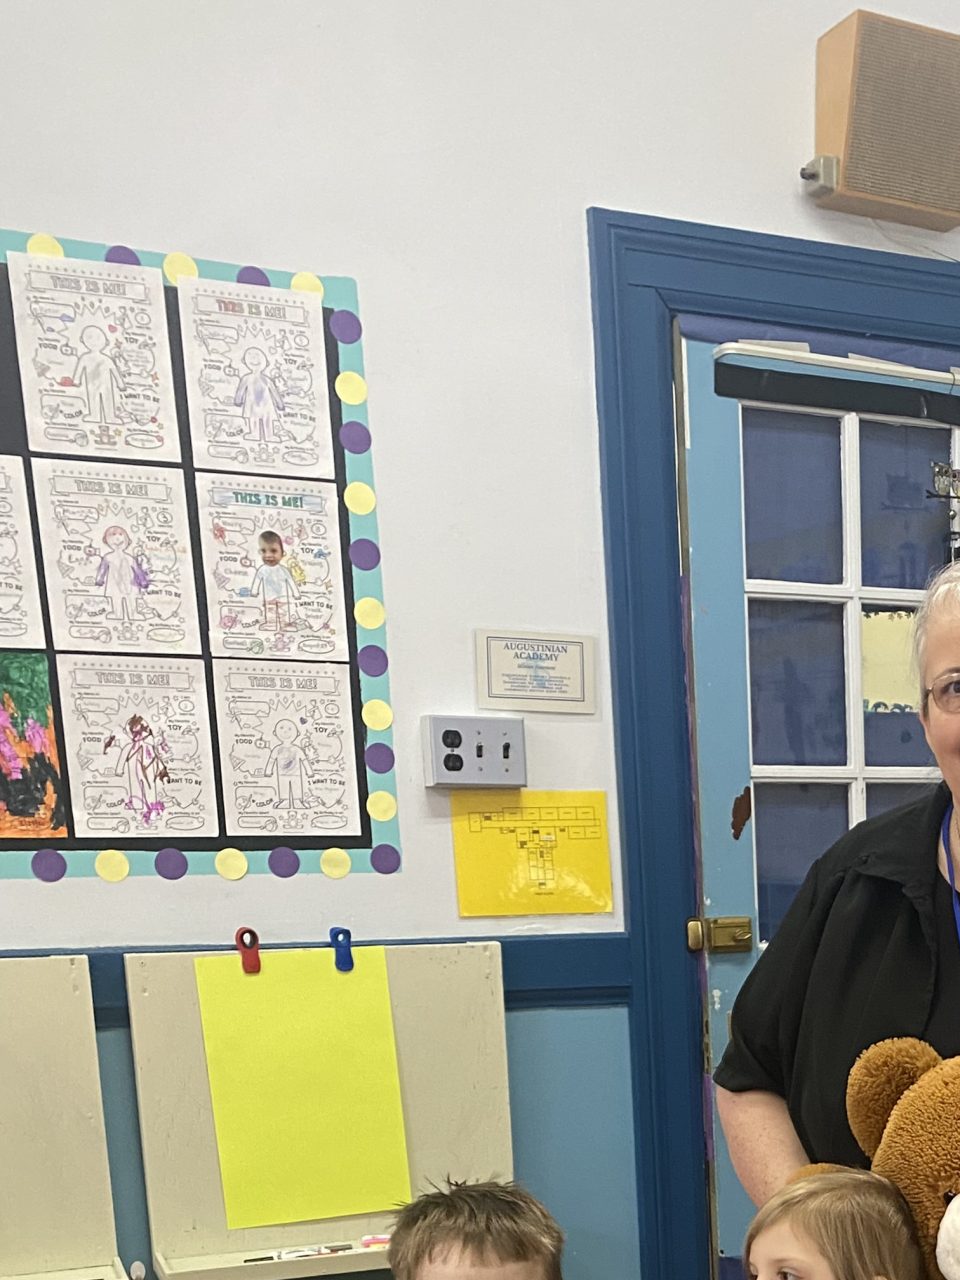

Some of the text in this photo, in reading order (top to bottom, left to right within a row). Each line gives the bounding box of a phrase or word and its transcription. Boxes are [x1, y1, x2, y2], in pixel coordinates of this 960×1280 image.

[51, 277, 127, 296] THIS IS ME!
[217, 300, 287, 319] THIS IS ME!
[124, 336, 138, 345] TOY
[284, 358, 297, 366] TOY
[75, 481, 149, 497] THIS IS ME!
[233, 493, 304, 508] THIS IS ME!
[504, 642, 568, 654] AUGUSTINIAN
[513, 652, 560, 662] ACADEMY
[97, 673, 170, 686] THIS IS ME!
[249, 677, 318, 690] THIS IS ME!
[168, 724, 182, 732] TOY
[314, 726, 328, 734] TOY
